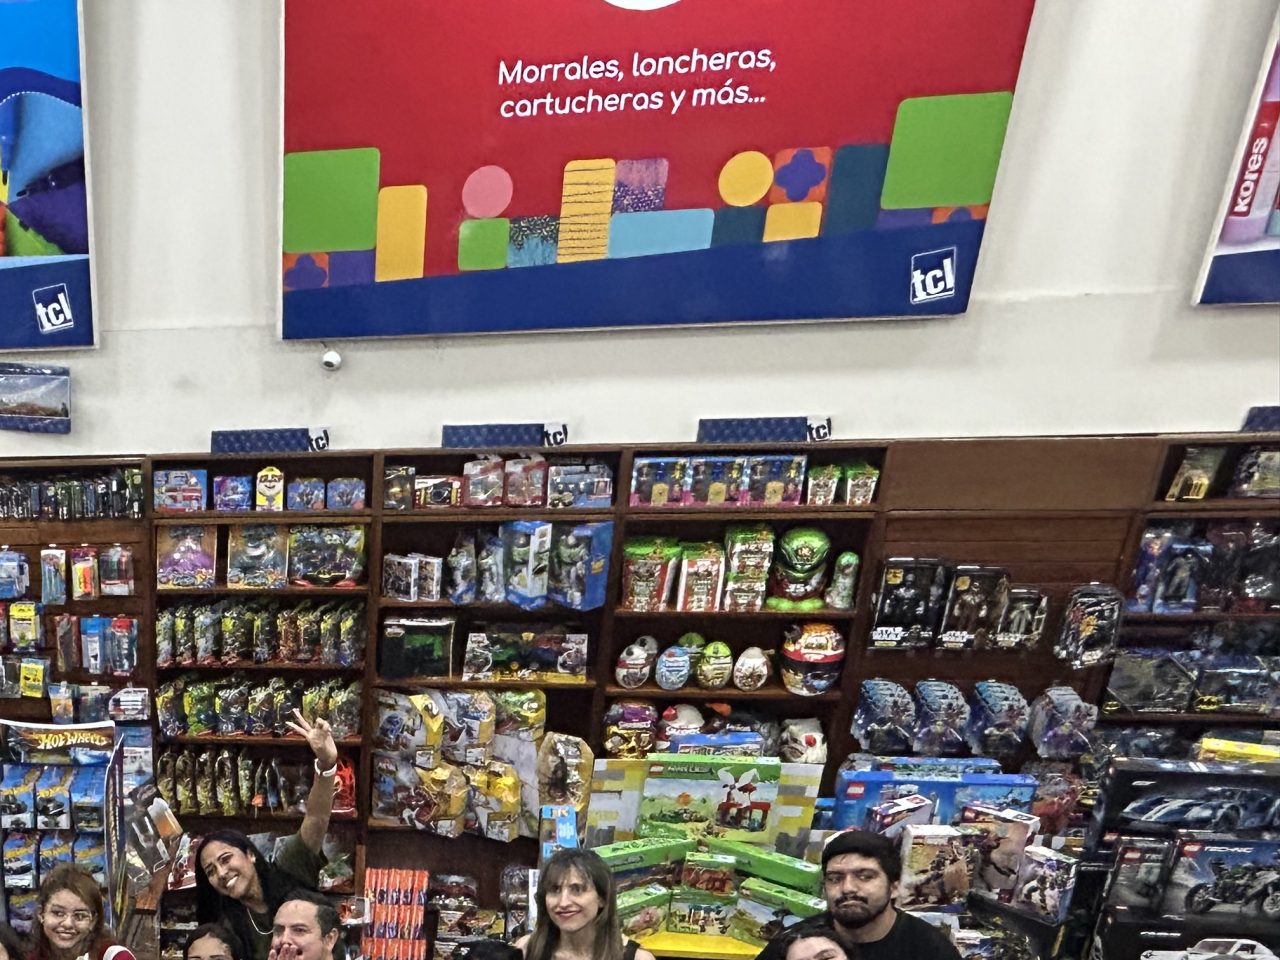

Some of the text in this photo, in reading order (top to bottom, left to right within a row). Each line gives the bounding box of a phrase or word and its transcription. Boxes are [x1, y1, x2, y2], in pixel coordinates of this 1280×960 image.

[498, 47, 777, 86] Morrales, loncheras,
[499, 78, 766, 118] cartucheras y más...
[913, 257, 955, 301] tcl
[36, 292, 73, 332] tcl
[543, 424, 568, 446] tcl
[807, 417, 832, 441] tcl
